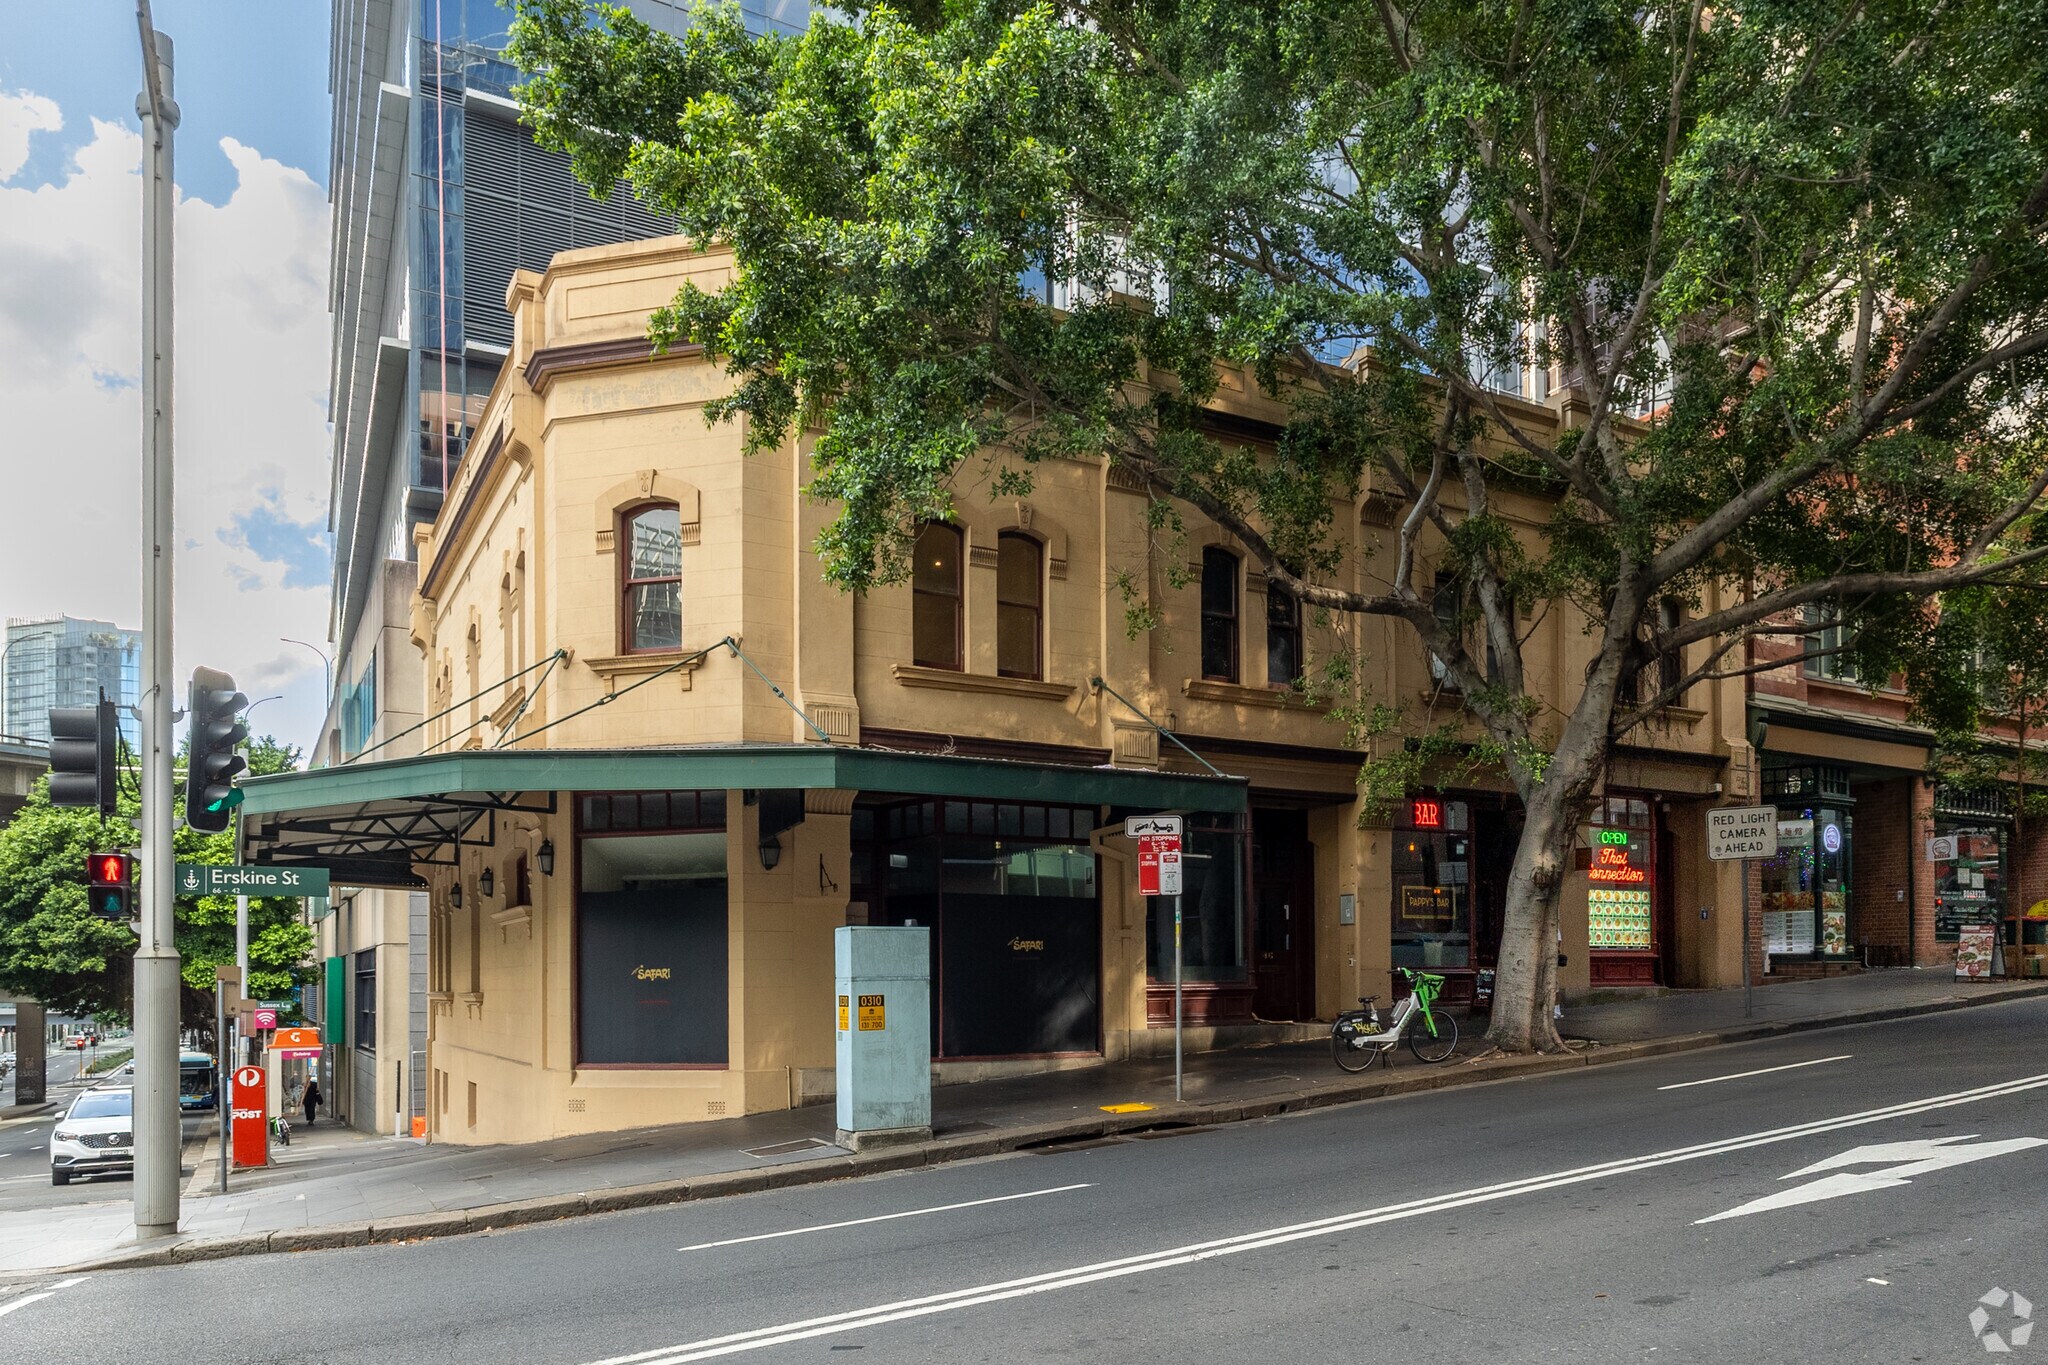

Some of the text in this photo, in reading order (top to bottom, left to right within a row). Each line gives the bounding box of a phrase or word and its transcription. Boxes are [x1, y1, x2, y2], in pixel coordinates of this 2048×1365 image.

[1415, 802, 1438, 825] BAR
[1713, 812, 1772, 826] RED LIGHT
[1601, 831, 1627, 845] OPEN
[1720, 827, 1767, 839] CAMERA
[1724, 841, 1764, 853] AHEAD
[1601, 847, 1628, 865] Thai
[211, 869, 300, 886] Erskine St
[1409, 896, 1450, 907] PAPPY'S BAR
[1012, 940, 1044, 952] SAFARI
[637, 968, 671, 981] SAFARI
[259, 1001, 281, 1009] Sussex
[860, 996, 882, 1006] 0310
[232, 1109, 263, 1120] POST
